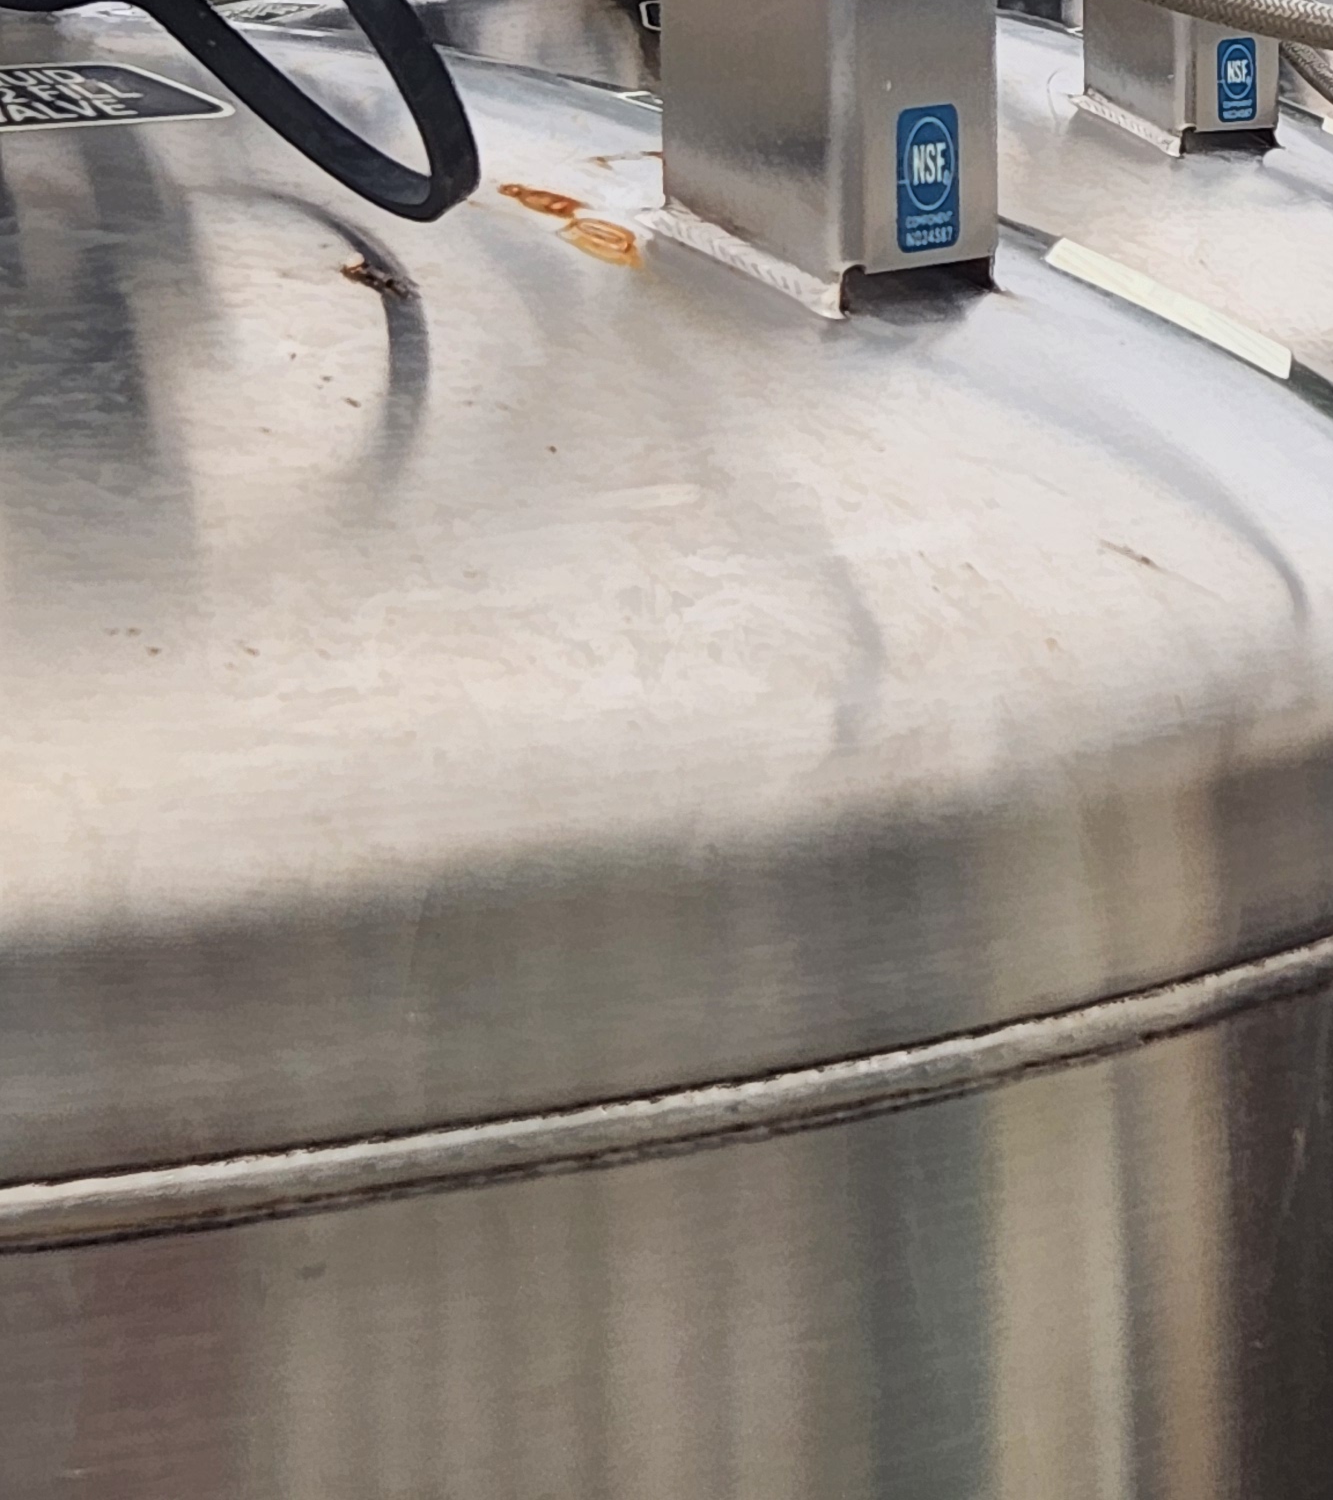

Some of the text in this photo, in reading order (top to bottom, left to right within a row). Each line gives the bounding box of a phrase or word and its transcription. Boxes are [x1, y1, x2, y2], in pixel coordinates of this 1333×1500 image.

[1226, 58, 1250, 85] NSF
[27, 81, 144, 101] FILL
[911, 141, 948, 187] NSF
